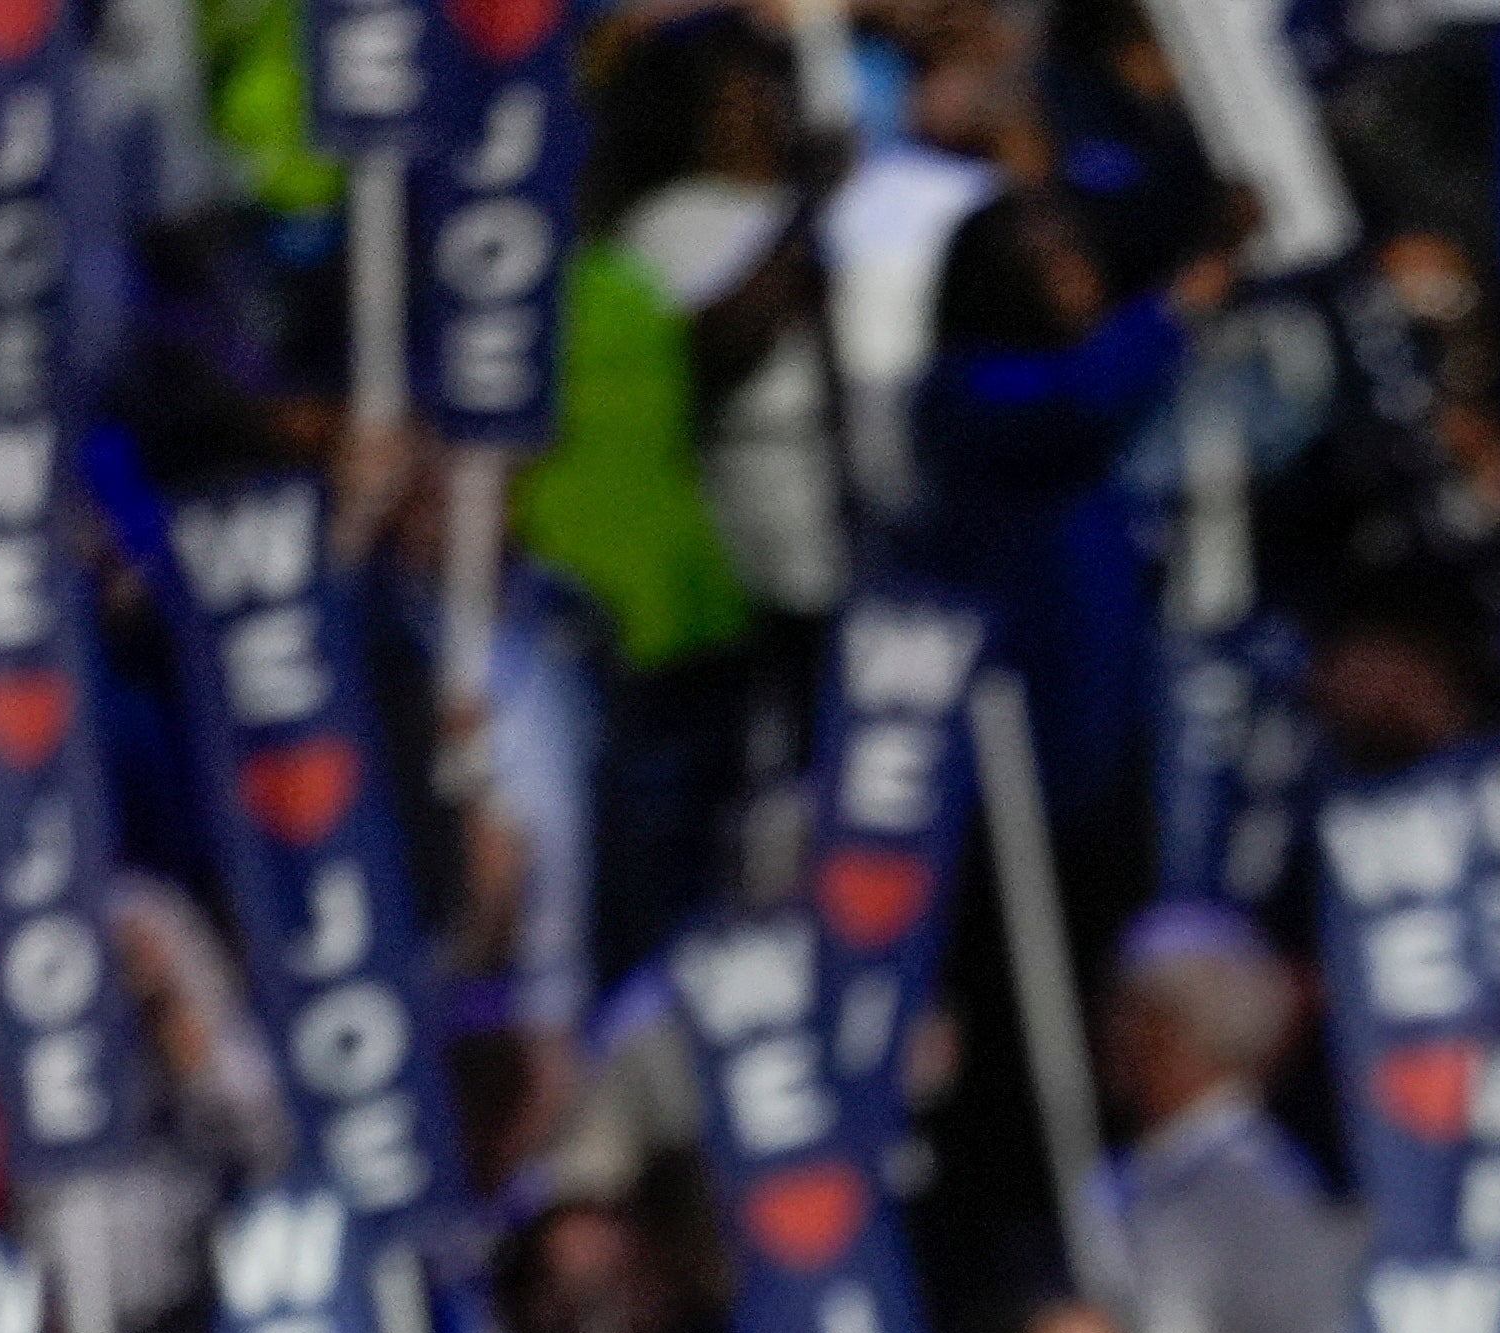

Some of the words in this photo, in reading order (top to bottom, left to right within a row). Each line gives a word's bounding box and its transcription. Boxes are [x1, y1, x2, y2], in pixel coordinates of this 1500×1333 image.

[440, 85, 560, 412] JOE
[168, 480, 345, 722] WE
[298, 855, 450, 1215] JOE
[830, 605, 980, 832] WE
[8, 805, 125, 1152] JOE
[675, 920, 842, 1165] WE
[1315, 795, 1475, 1022] WE
